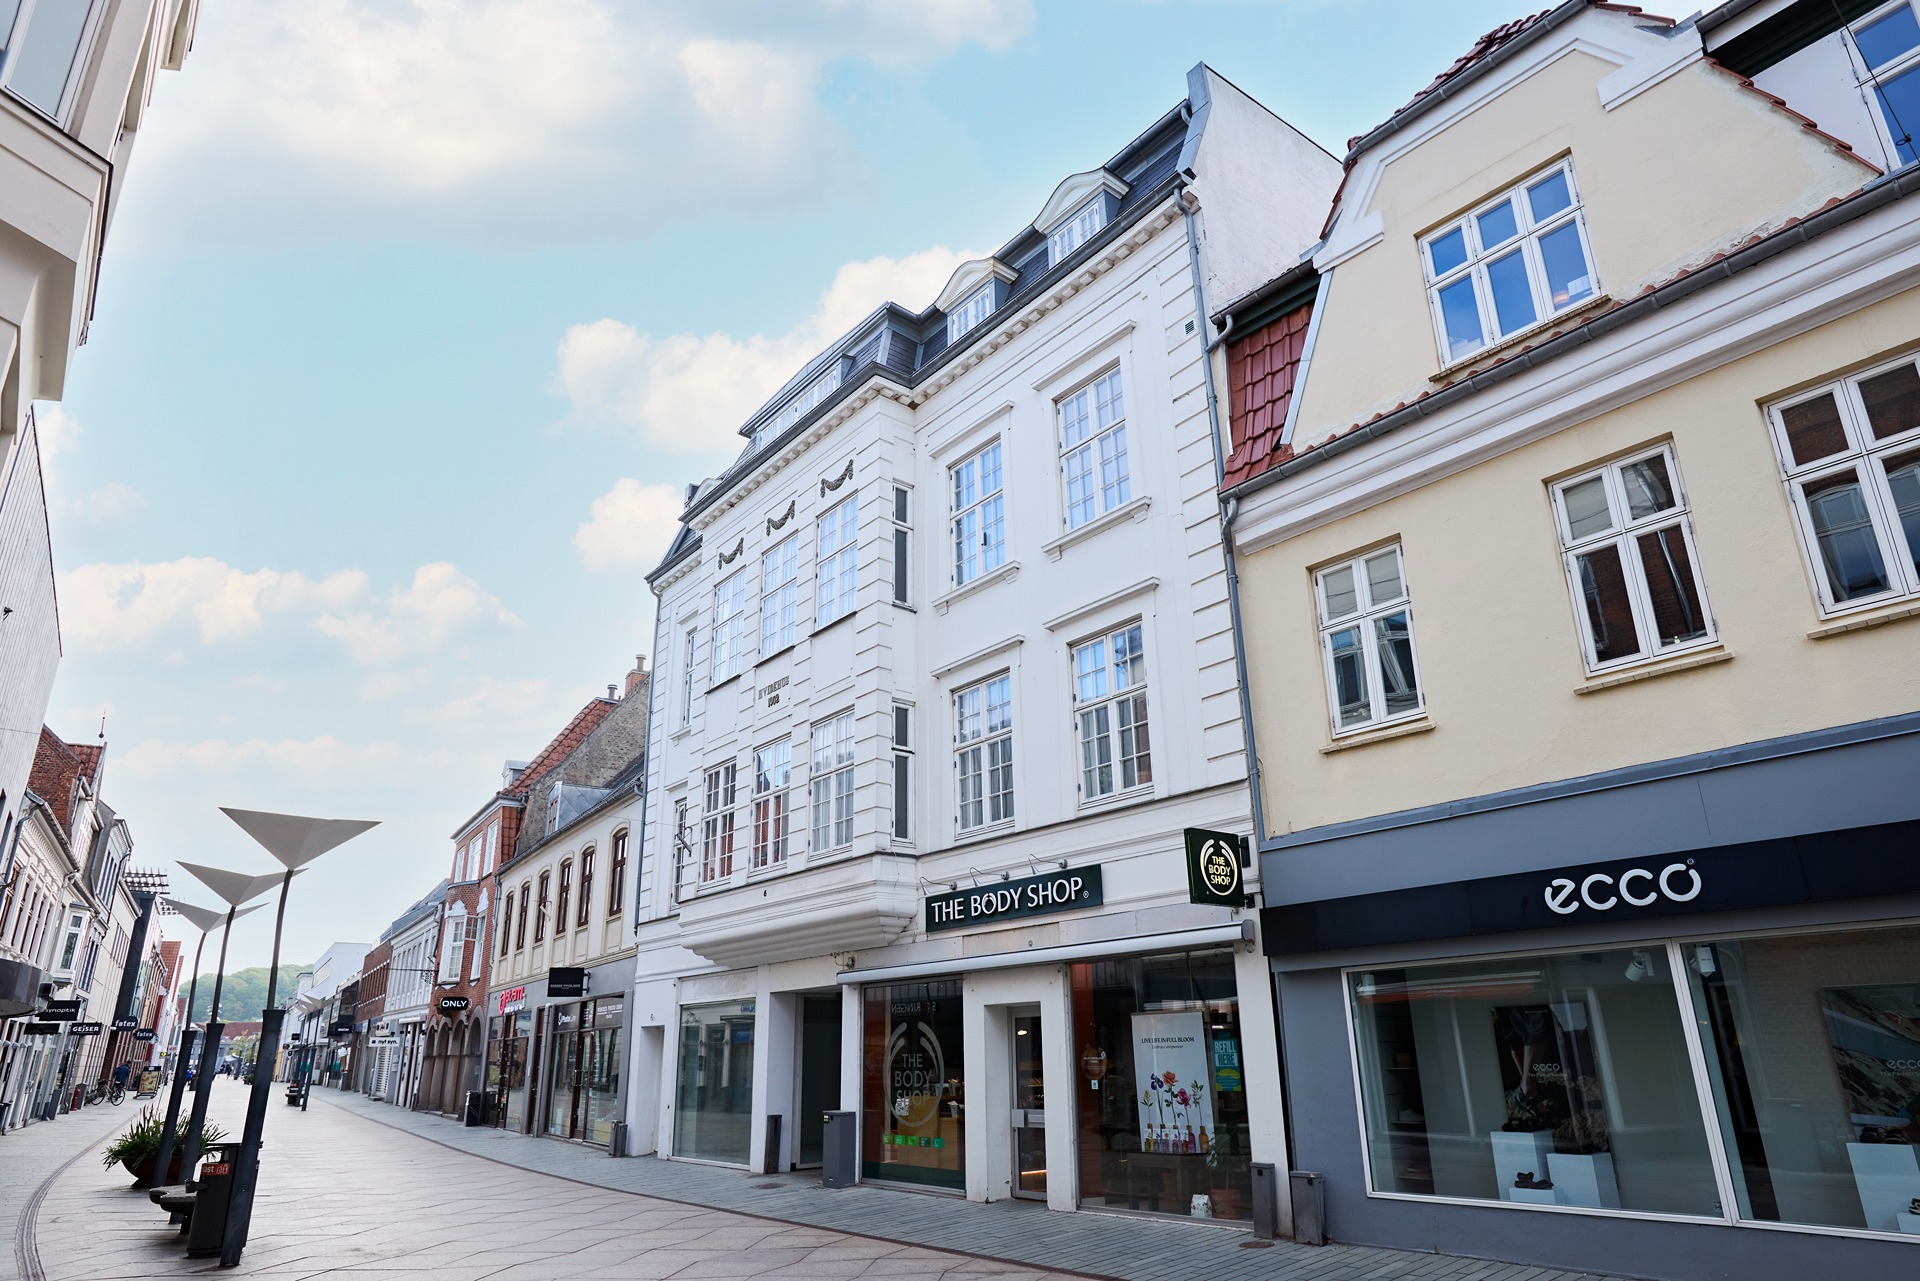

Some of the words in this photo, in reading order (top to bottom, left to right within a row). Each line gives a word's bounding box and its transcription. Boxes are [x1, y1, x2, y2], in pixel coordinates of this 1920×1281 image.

[1211, 855, 1226, 866] THE
[1208, 864, 1231, 876] BODY
[1210, 874, 1231, 886] SHOP
[1544, 863, 1702, 915] ecco
[931, 898, 965, 923] THE
[970, 886, 1023, 917] BODY
[1027, 876, 1083, 908] SHOP
[442, 1000, 468, 1009] ONLY
[115, 1019, 136, 1027] føtex
[1214, 1040, 1237, 1053] REFILL
[901, 1053, 923, 1068] THE
[1217, 1053, 1236, 1066] HERE
[1532, 1063, 1560, 1071] ecco
[894, 1070, 931, 1088] BODY
[896, 1089, 930, 1107] SHOP
